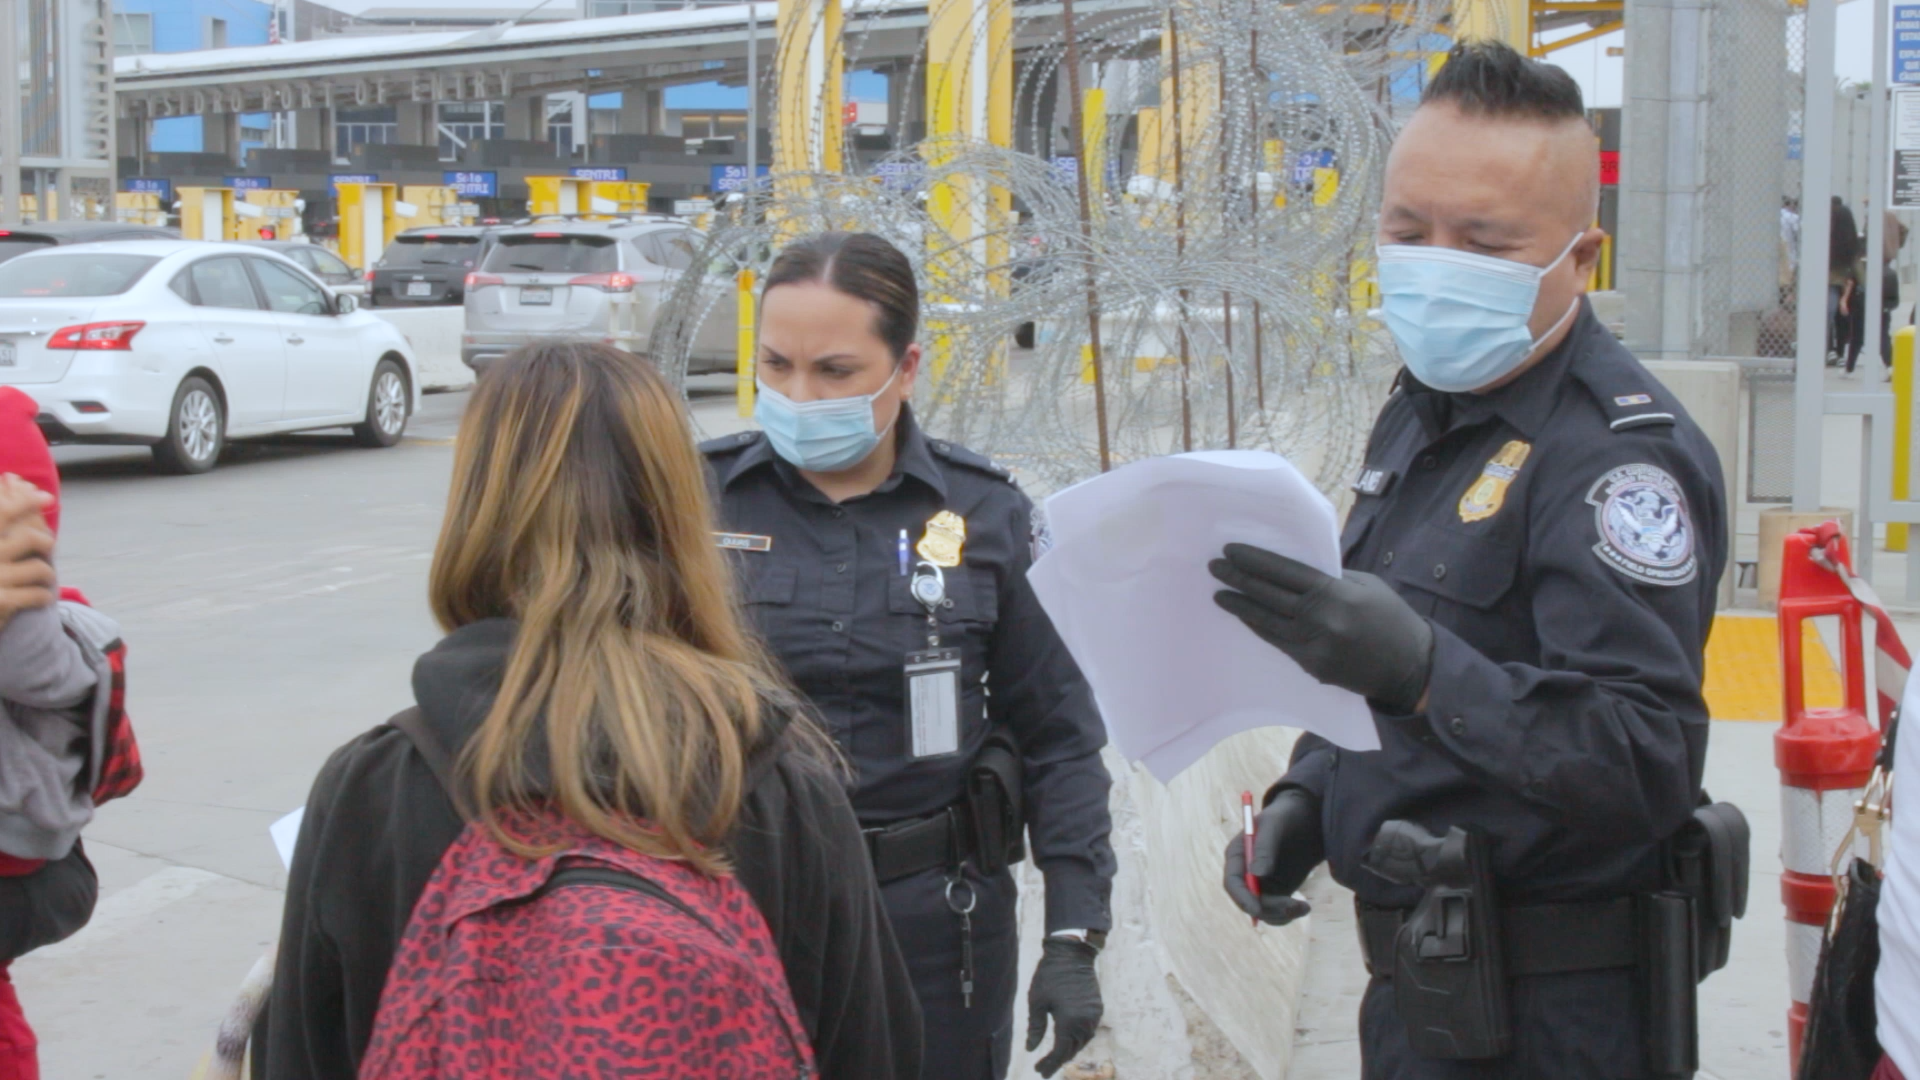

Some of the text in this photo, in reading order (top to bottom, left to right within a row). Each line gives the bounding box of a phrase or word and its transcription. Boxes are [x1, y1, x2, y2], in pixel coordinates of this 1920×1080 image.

[262, 81, 333, 110] PORT
[355, 78, 387, 106] OF
[411, 68, 514, 102] ENTRY
[455, 172, 483, 183] Solo
[575, 169, 618, 180] SENTRI
